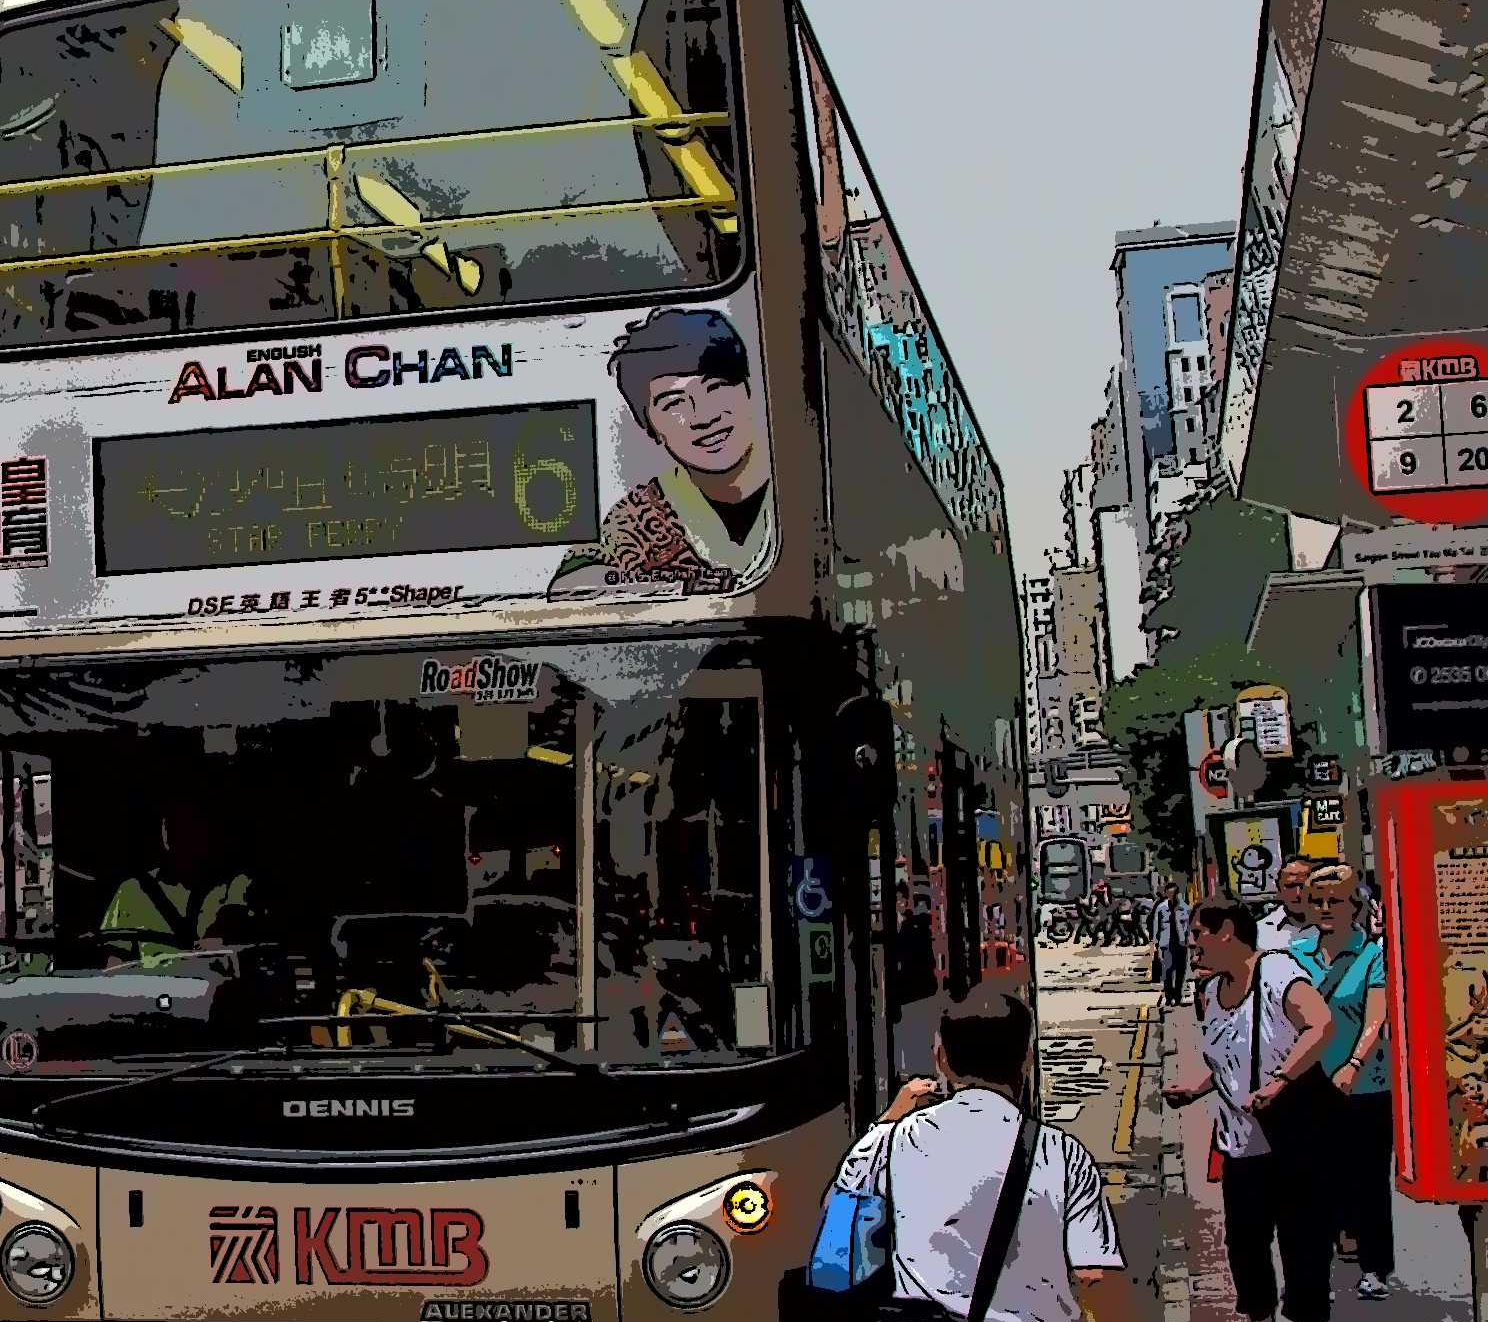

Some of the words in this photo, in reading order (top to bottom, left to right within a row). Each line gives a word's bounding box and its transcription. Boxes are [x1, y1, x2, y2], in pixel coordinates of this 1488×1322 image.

[246, 344, 322, 364] ENGLISH
[168, 359, 323, 404] ALAN
[345, 343, 514, 389] CHAN
[1423, 357, 1479, 381] KMB
[1396, 399, 1415, 424] 2
[1399, 450, 1417, 475] 9
[1457, 447, 1488, 472] 20
[513, 427, 577, 534] 6
[187, 595, 234, 616] DSE
[421, 657, 539, 693] RoadShow
[282, 1099, 416, 1118] DENNIS
[293, 1206, 491, 1287] KMB
[423, 1301, 589, 1322] ALEXANDER
